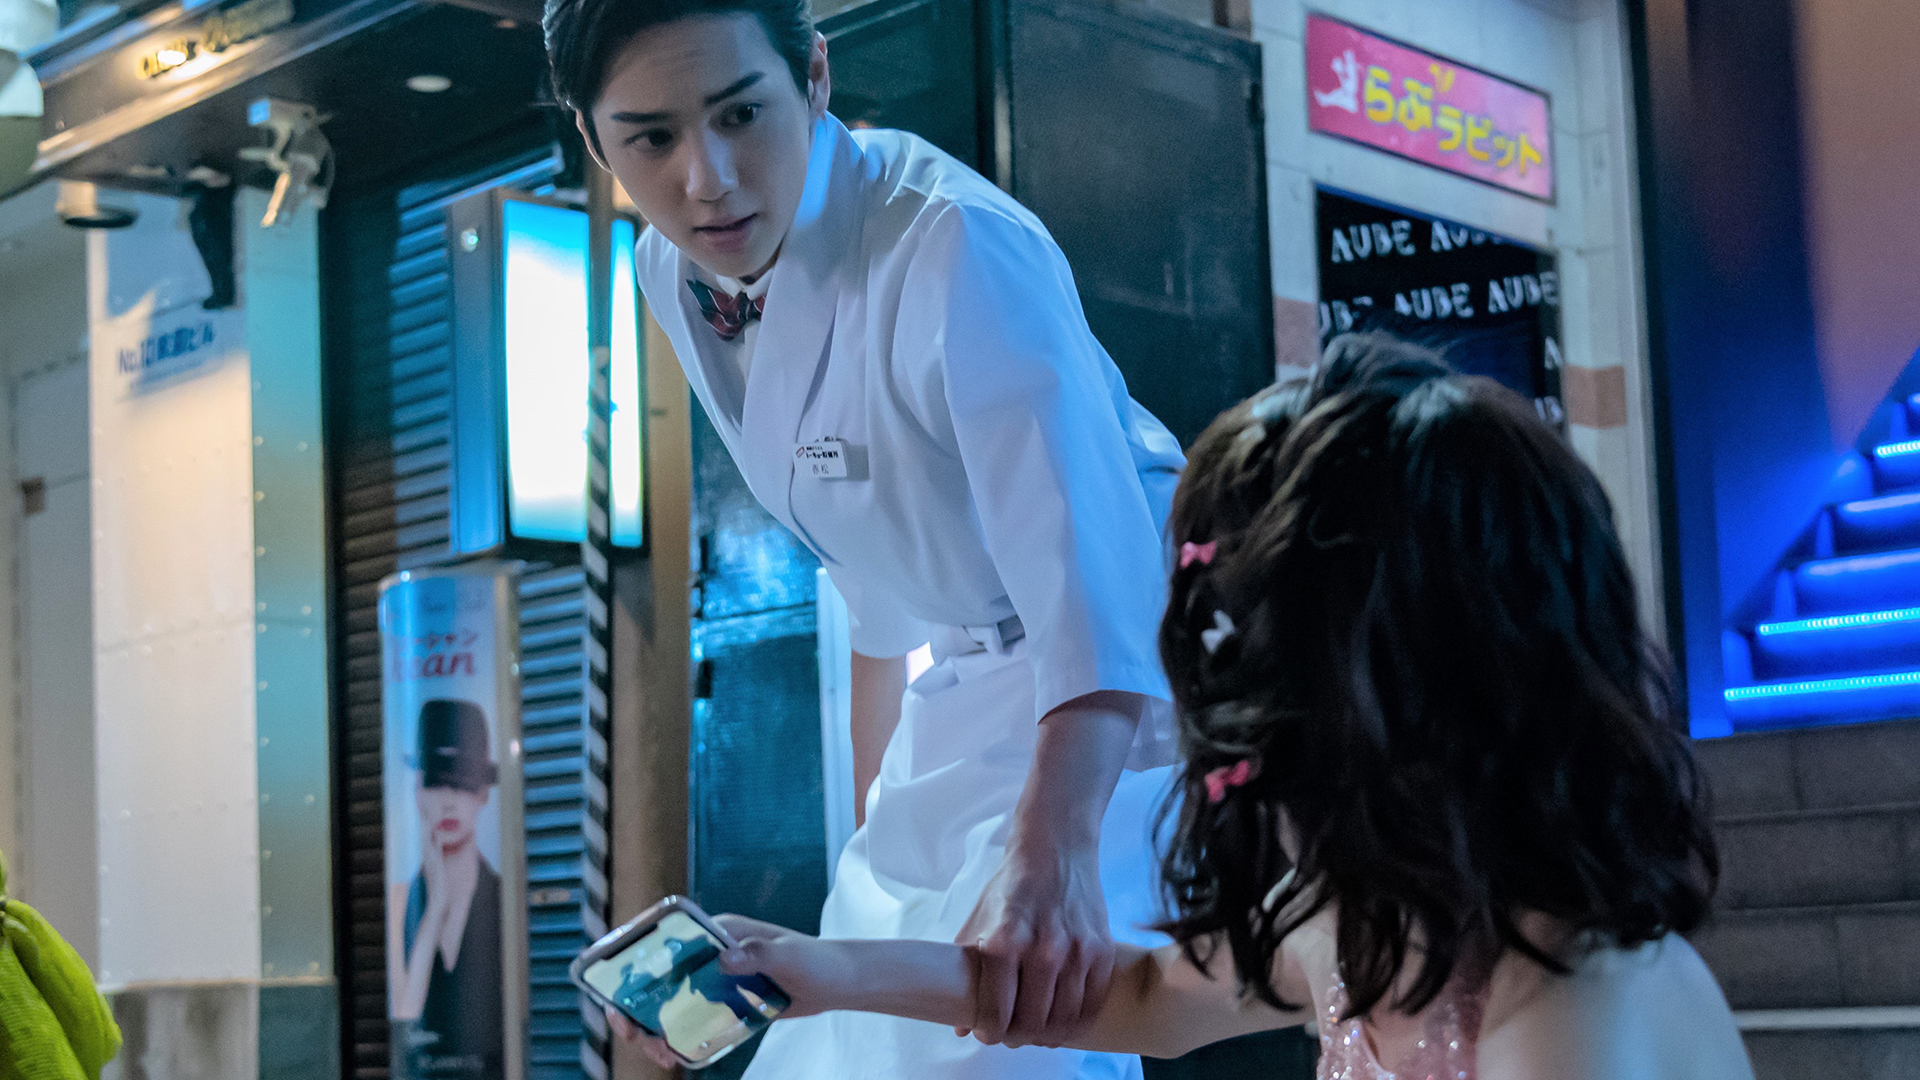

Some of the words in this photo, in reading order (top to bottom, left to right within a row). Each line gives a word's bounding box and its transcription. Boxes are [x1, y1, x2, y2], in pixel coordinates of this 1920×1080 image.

[1364, 64, 1542, 176] らぶラビット
[1331, 219, 1417, 264] AUBE
[1487, 271, 1560, 315] AUBE
